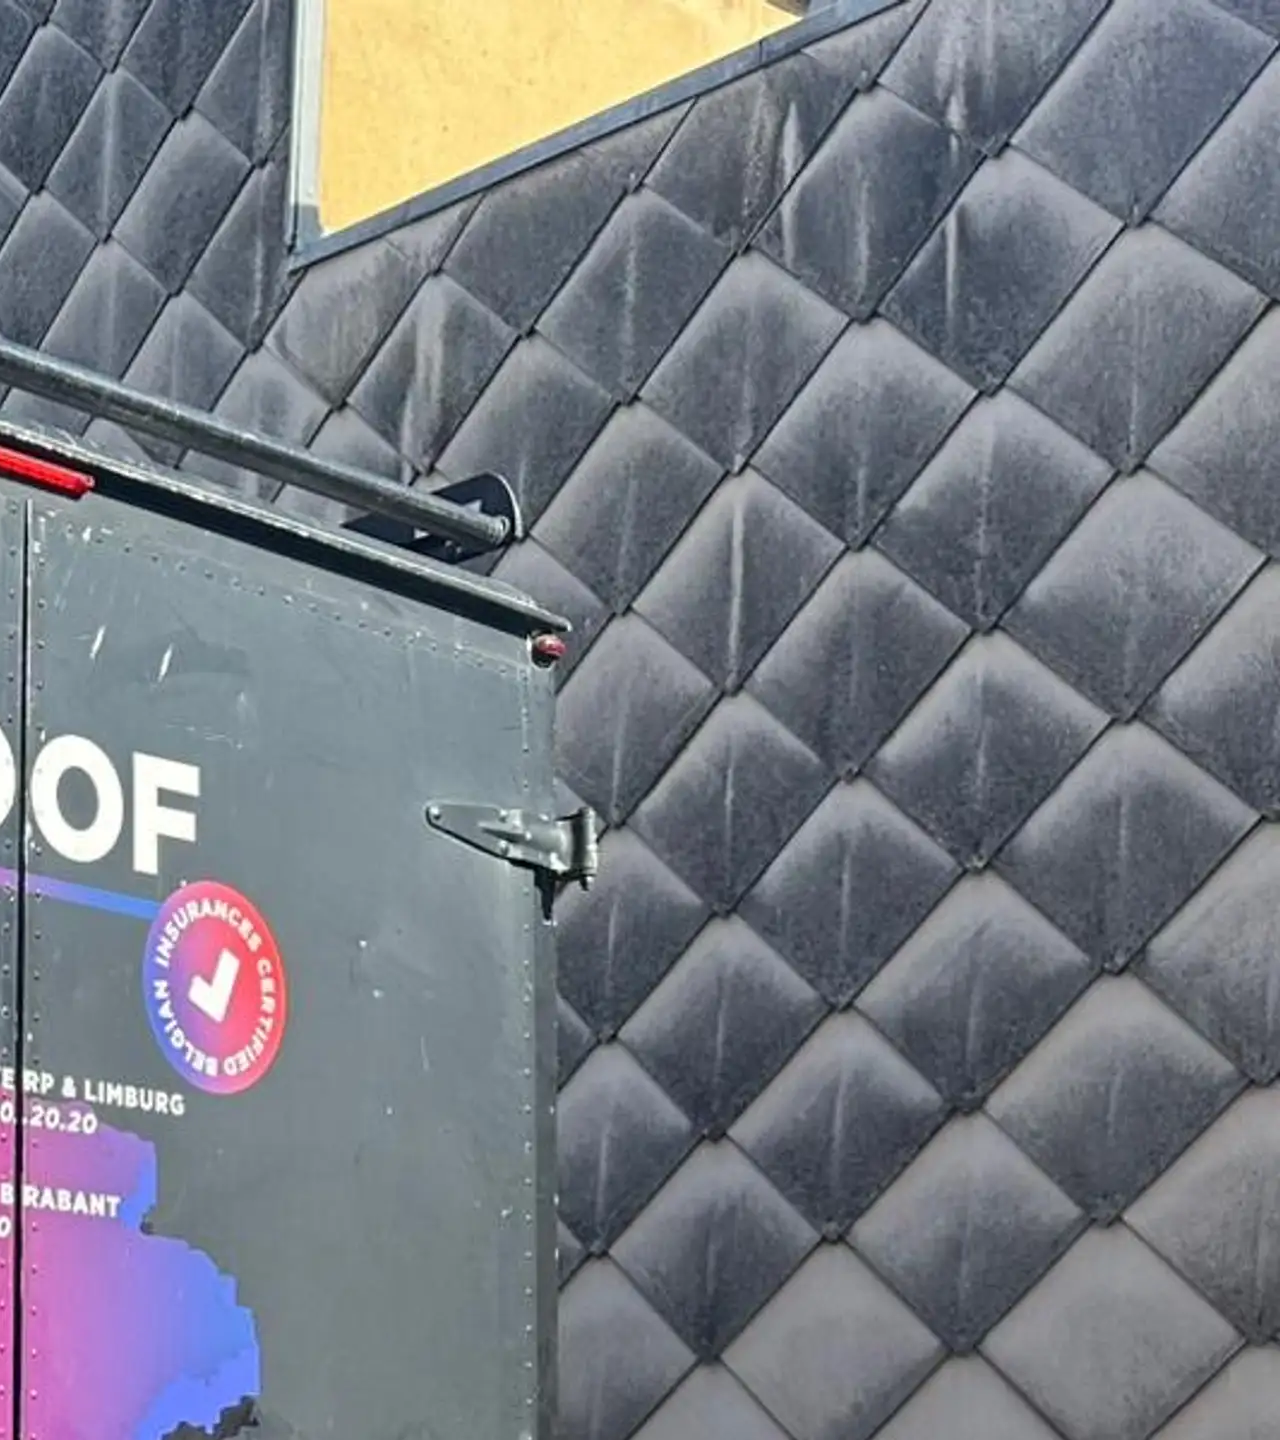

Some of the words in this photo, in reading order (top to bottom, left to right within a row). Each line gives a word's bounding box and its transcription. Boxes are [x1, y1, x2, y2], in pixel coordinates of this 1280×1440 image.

[154, 898, 264, 968] INSURANCES
[152, 979, 219, 1077] BELGIAN
[223, 958, 277, 1077] CERTIFIED
[61, 1076, 78, 1099] &
[84, 1077, 187, 1117] LIMBURG
[0, 1181, 122, 1219] BRABANT
